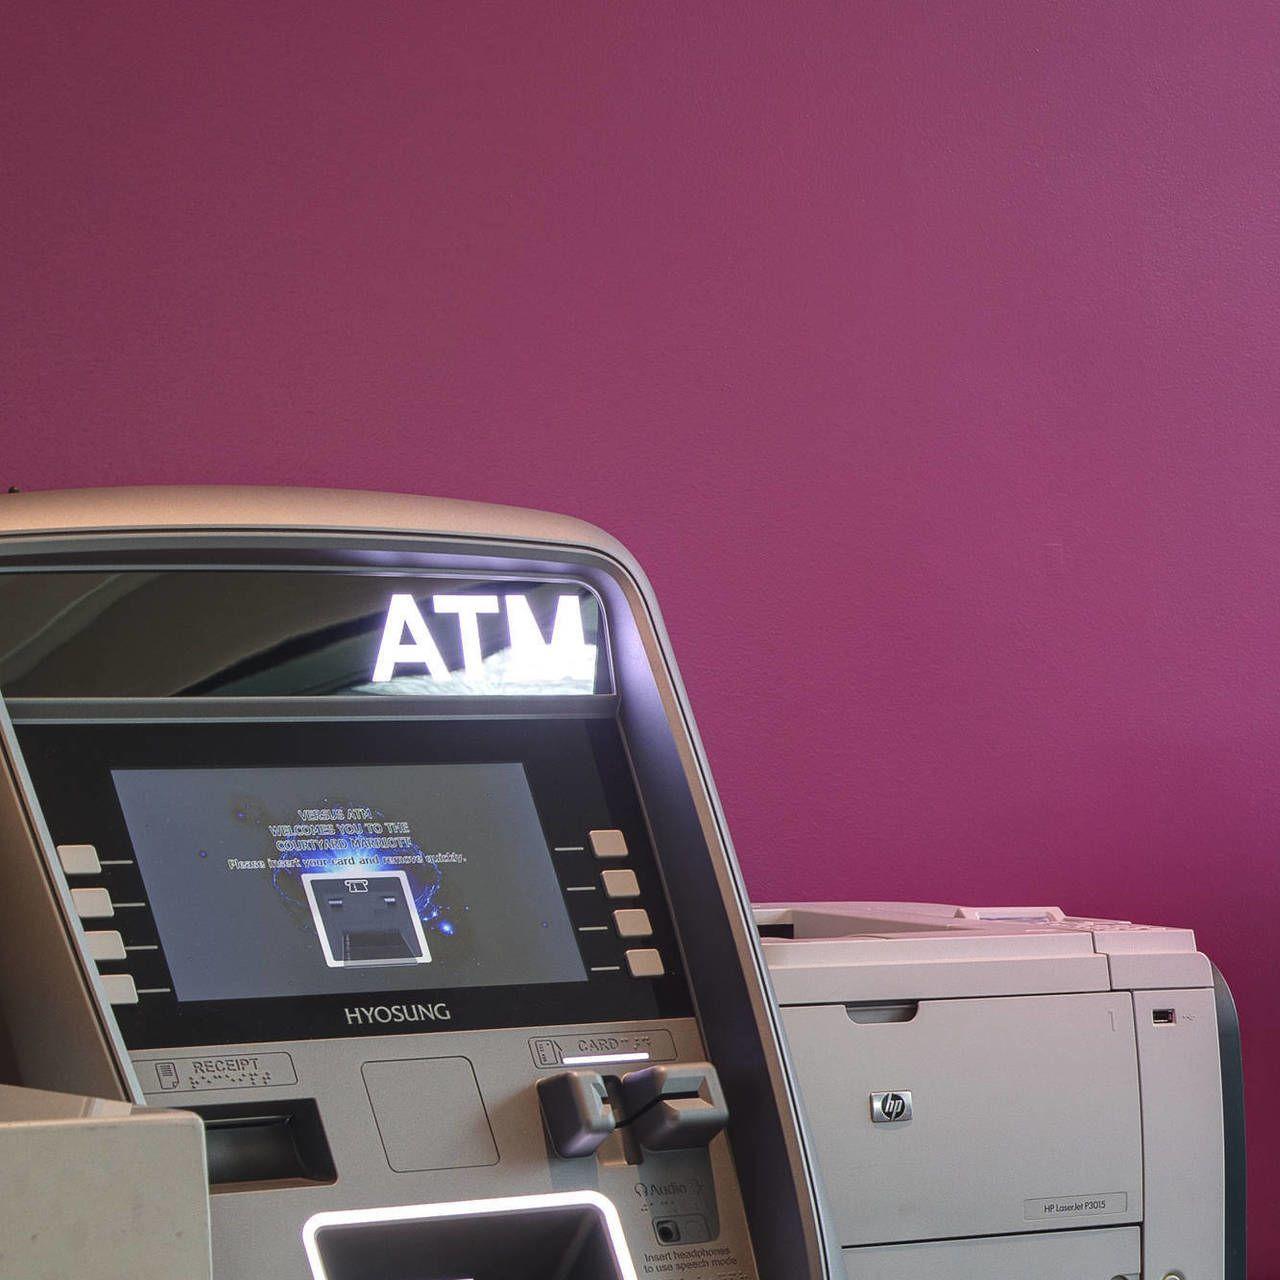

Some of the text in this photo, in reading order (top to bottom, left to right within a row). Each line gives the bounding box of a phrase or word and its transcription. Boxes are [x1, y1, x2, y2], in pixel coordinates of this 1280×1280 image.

[372, 594, 596, 683] ATM
[268, 822, 410, 837] WELCOMES YOU TO THE
[276, 838, 348, 851] COURTYARD
[227, 857, 266, 870] Please
[302, 858, 329, 870] your
[331, 855, 356, 867] card
[359, 853, 379, 865] and
[344, 1003, 451, 1025] HYOSUNG
[577, 1037, 619, 1052] CARD
[192, 1057, 259, 1074] RECEIPT
[650, 1181, 687, 1198] Audio
[1043, 1200, 1106, 1213] HP LaserJet P3015
[644, 1247, 731, 1263] Insert headphones
[643, 1257, 738, 1274] to use speech mode
